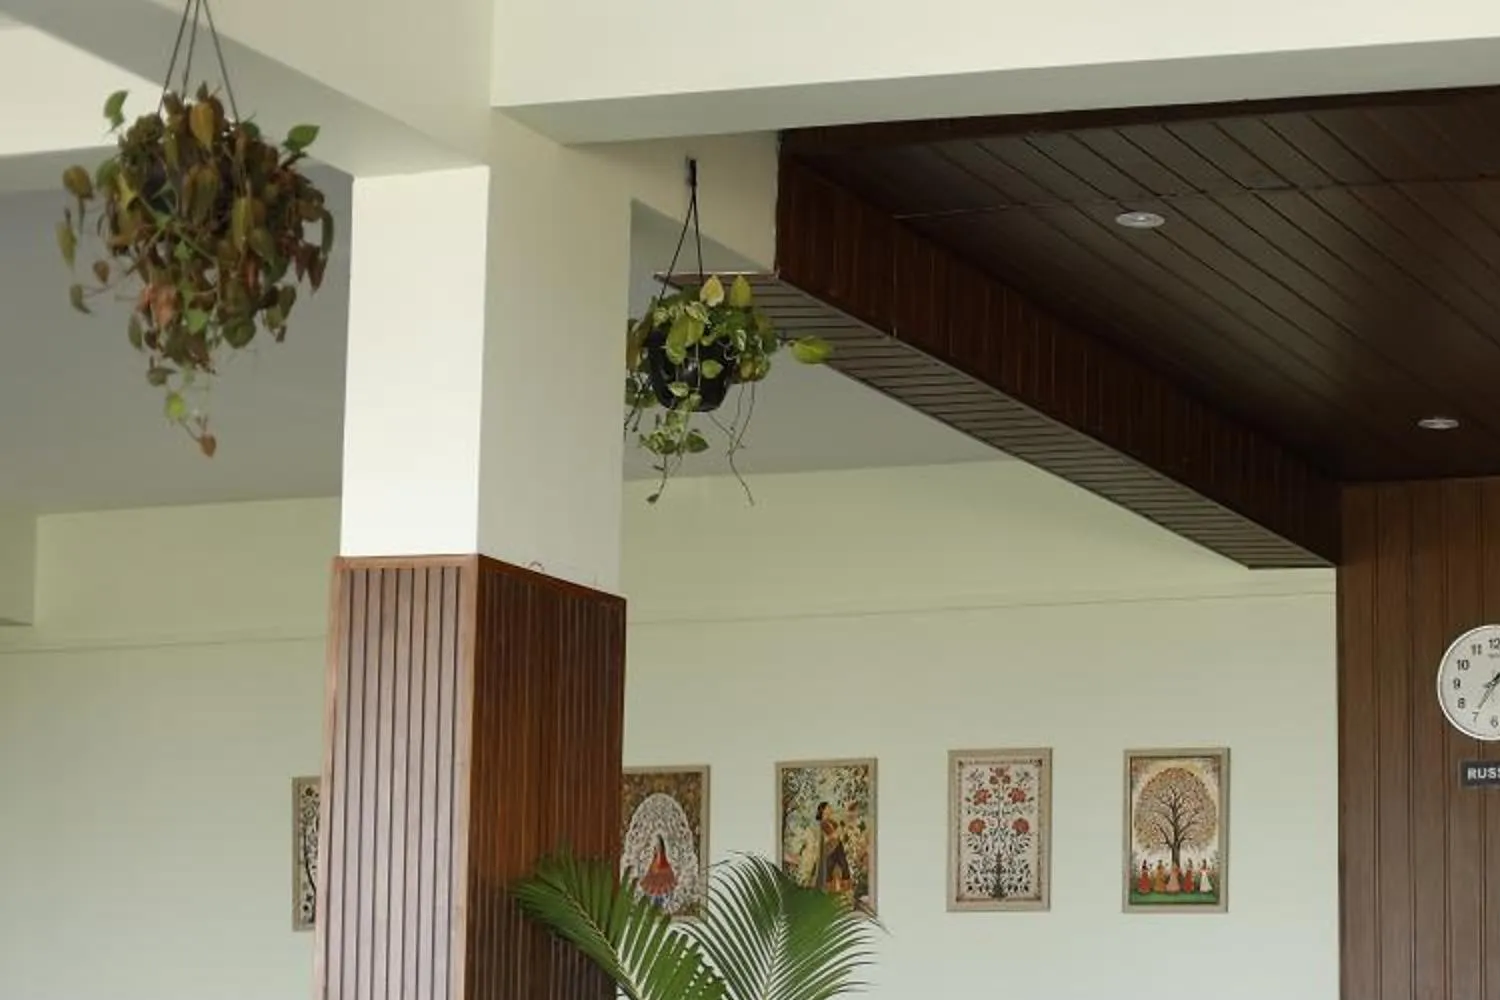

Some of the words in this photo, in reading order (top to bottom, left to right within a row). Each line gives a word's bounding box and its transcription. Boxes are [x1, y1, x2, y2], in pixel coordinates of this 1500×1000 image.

[1489, 638, 1500, 648] 12
[1472, 644, 1481, 654] 11
[1457, 659, 1469, 670] 10
[1453, 678, 1460, 689] 9
[1458, 698, 1465, 708] 8
[1472, 712, 1478, 721] 7
[1491, 716, 1498, 728] 6
